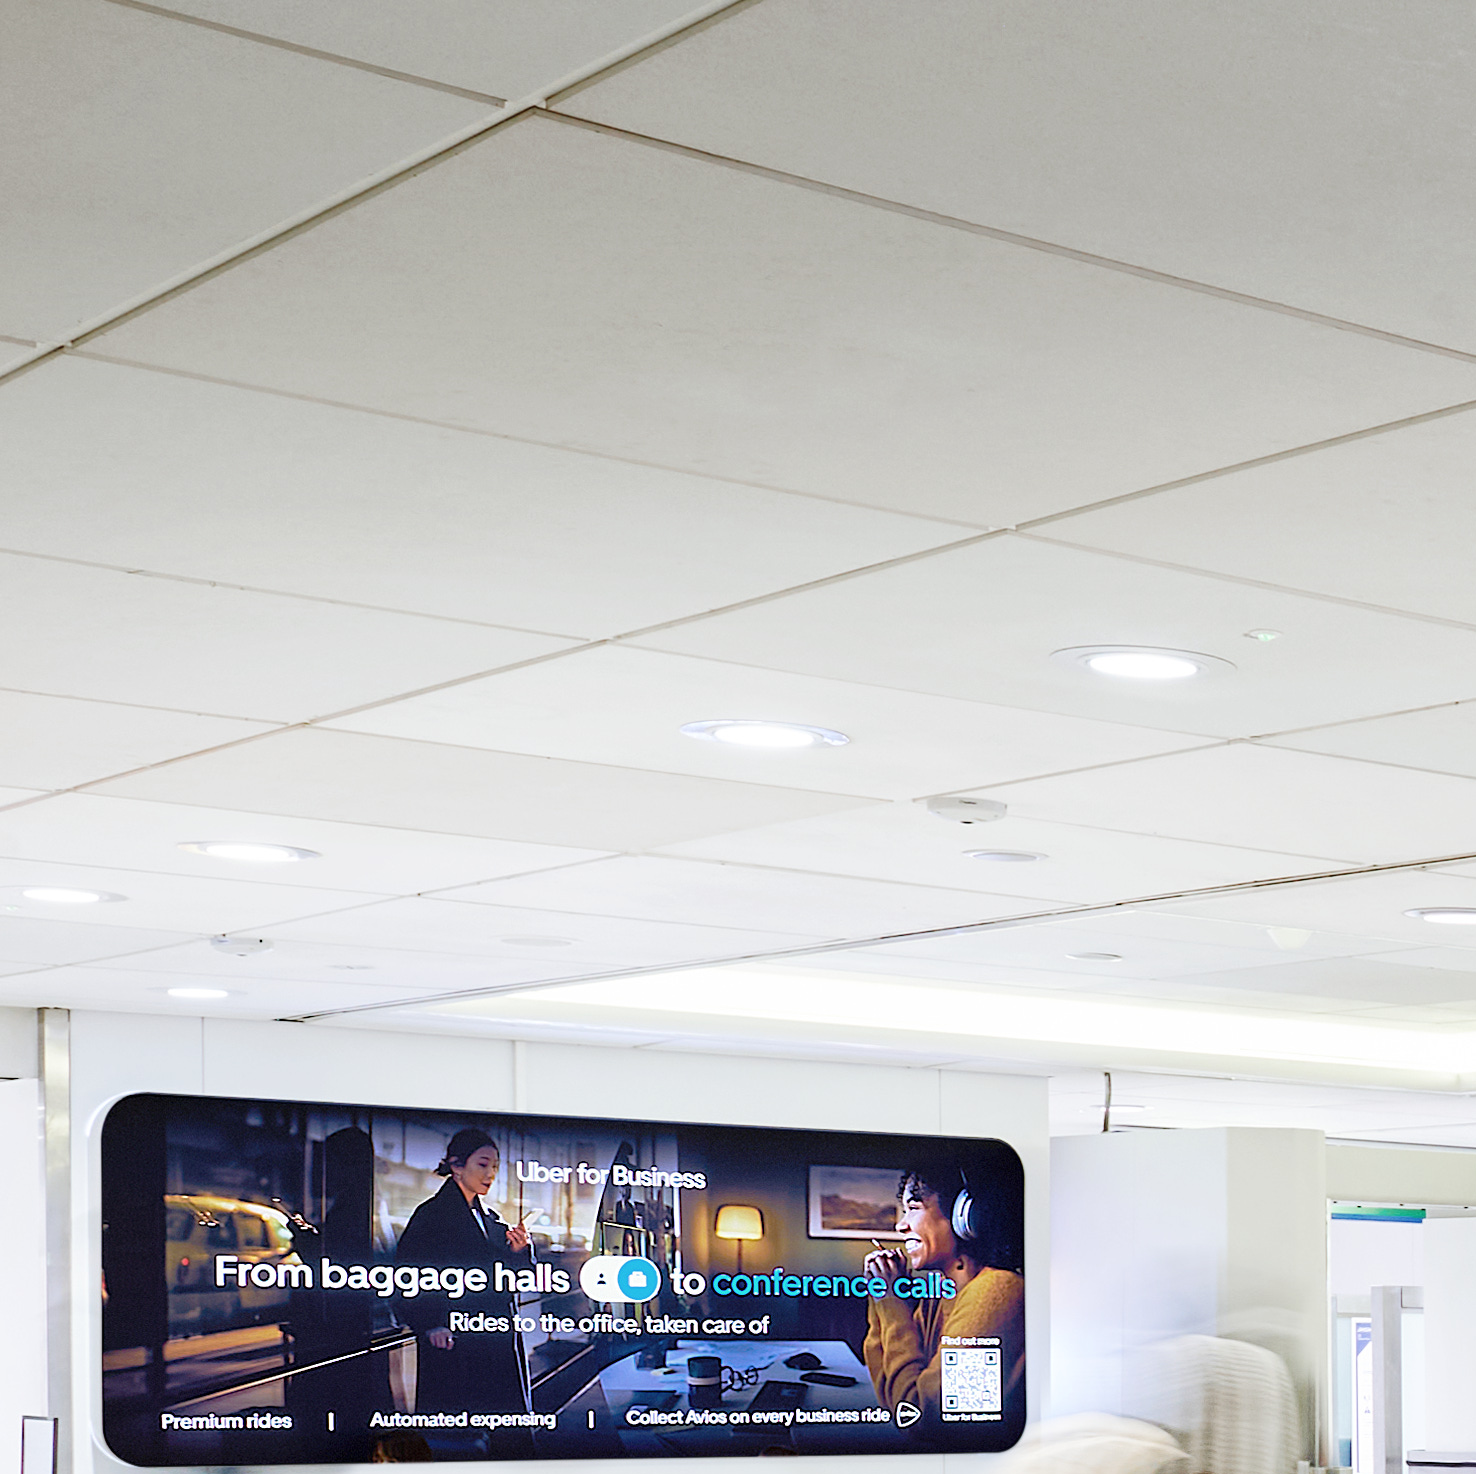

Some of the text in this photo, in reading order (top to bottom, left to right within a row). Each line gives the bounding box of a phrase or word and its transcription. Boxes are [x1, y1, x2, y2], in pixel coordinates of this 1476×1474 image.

[517, 1161, 707, 1190] Uber for Business
[215, 1255, 957, 1300] From baggage halls to conference calls
[449, 1312, 769, 1337] Rides to the office, taken care of
[161, 1413, 292, 1430] Premium rides
[370, 1411, 556, 1430] Automated expensing
[626, 1408, 684, 1426] Collect
[686, 1408, 727, 1425] Avios
[729, 1414, 749, 1425] on
[752, 1413, 793, 1429] every
[795, 1408, 859, 1424] business
[862, 1407, 890, 1423] ride
